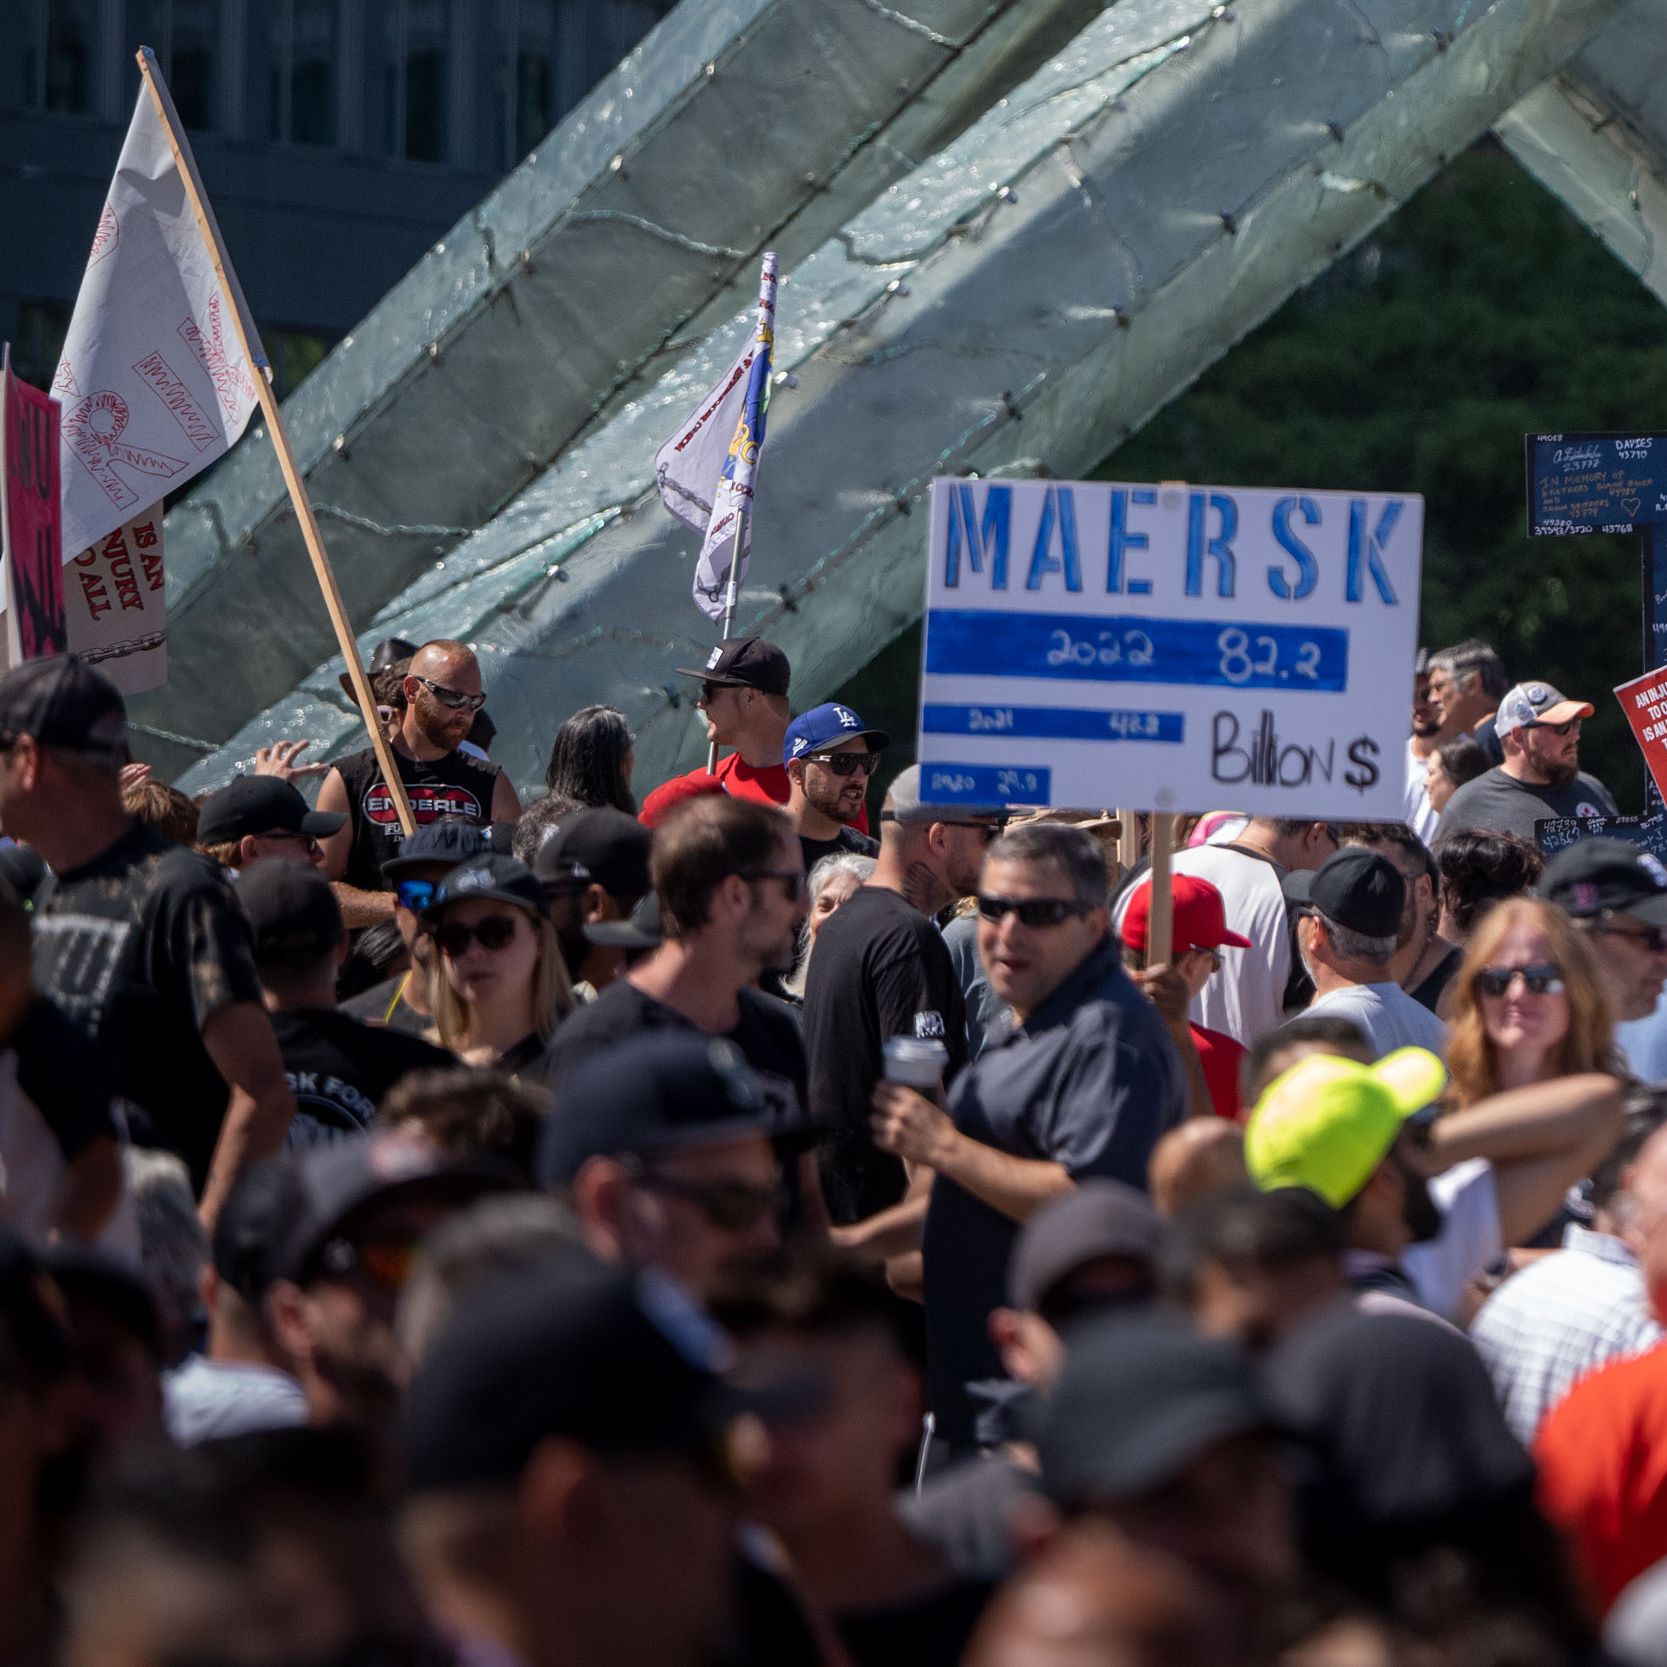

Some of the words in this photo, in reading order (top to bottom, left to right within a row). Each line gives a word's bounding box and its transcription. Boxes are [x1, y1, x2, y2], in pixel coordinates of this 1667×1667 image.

[1615, 438, 1653, 450] DAVIES
[944, 484, 1405, 605] MAERSK
[74, 546, 97, 567] O
[102, 526, 144, 611] NJURY
[1047, 629, 1154, 666] 2022
[1218, 628, 1322, 683] 82.2
[1635, 692, 1650, 709] AN
[1648, 706, 1662, 721] TO
[1642, 728, 1655, 742] IS
[1654, 721, 1667, 739] AN
